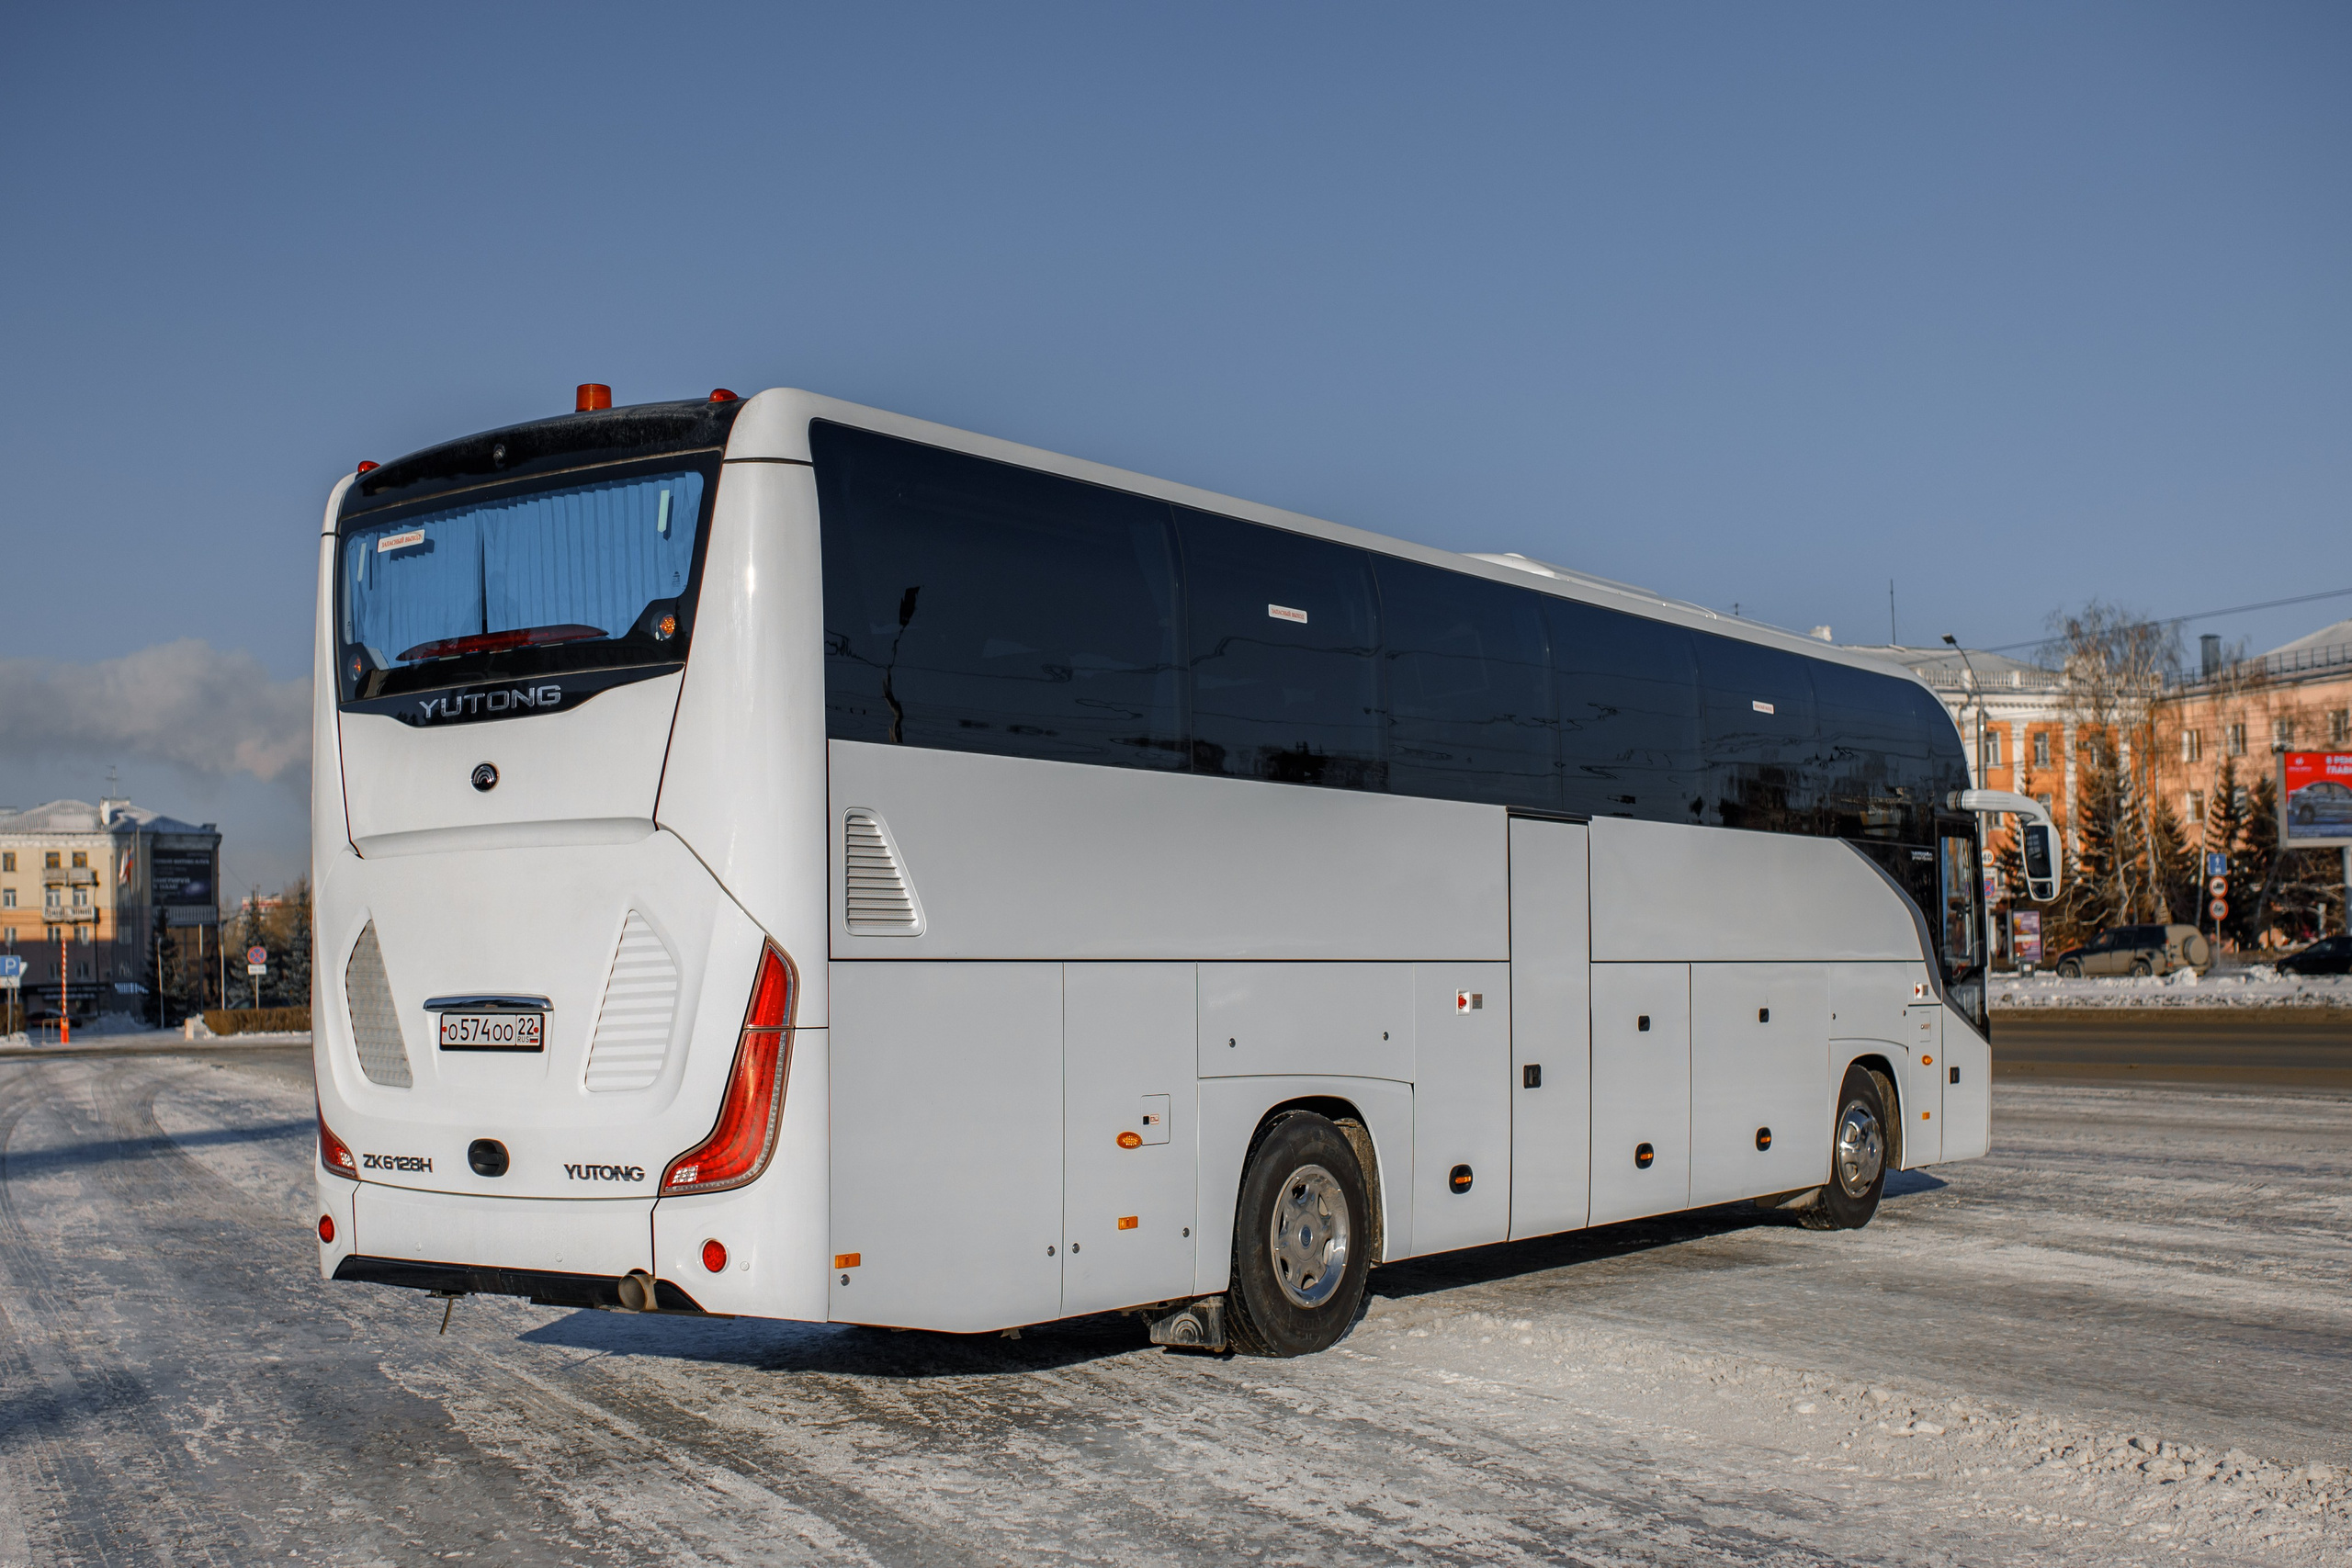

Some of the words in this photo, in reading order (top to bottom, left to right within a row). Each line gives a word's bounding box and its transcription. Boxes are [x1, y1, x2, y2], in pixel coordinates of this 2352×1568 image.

[381, 536, 404, 547] ЗАПАСНЫЙ
[405, 534, 422, 543] ВЫХОД
[419, 684, 561, 718] YUTONG
[5, 957, 17, 975] P
[518, 1018, 535, 1035] 22
[363, 1154, 433, 1173] ZK6128H
[563, 1164, 646, 1182] YUTONG
